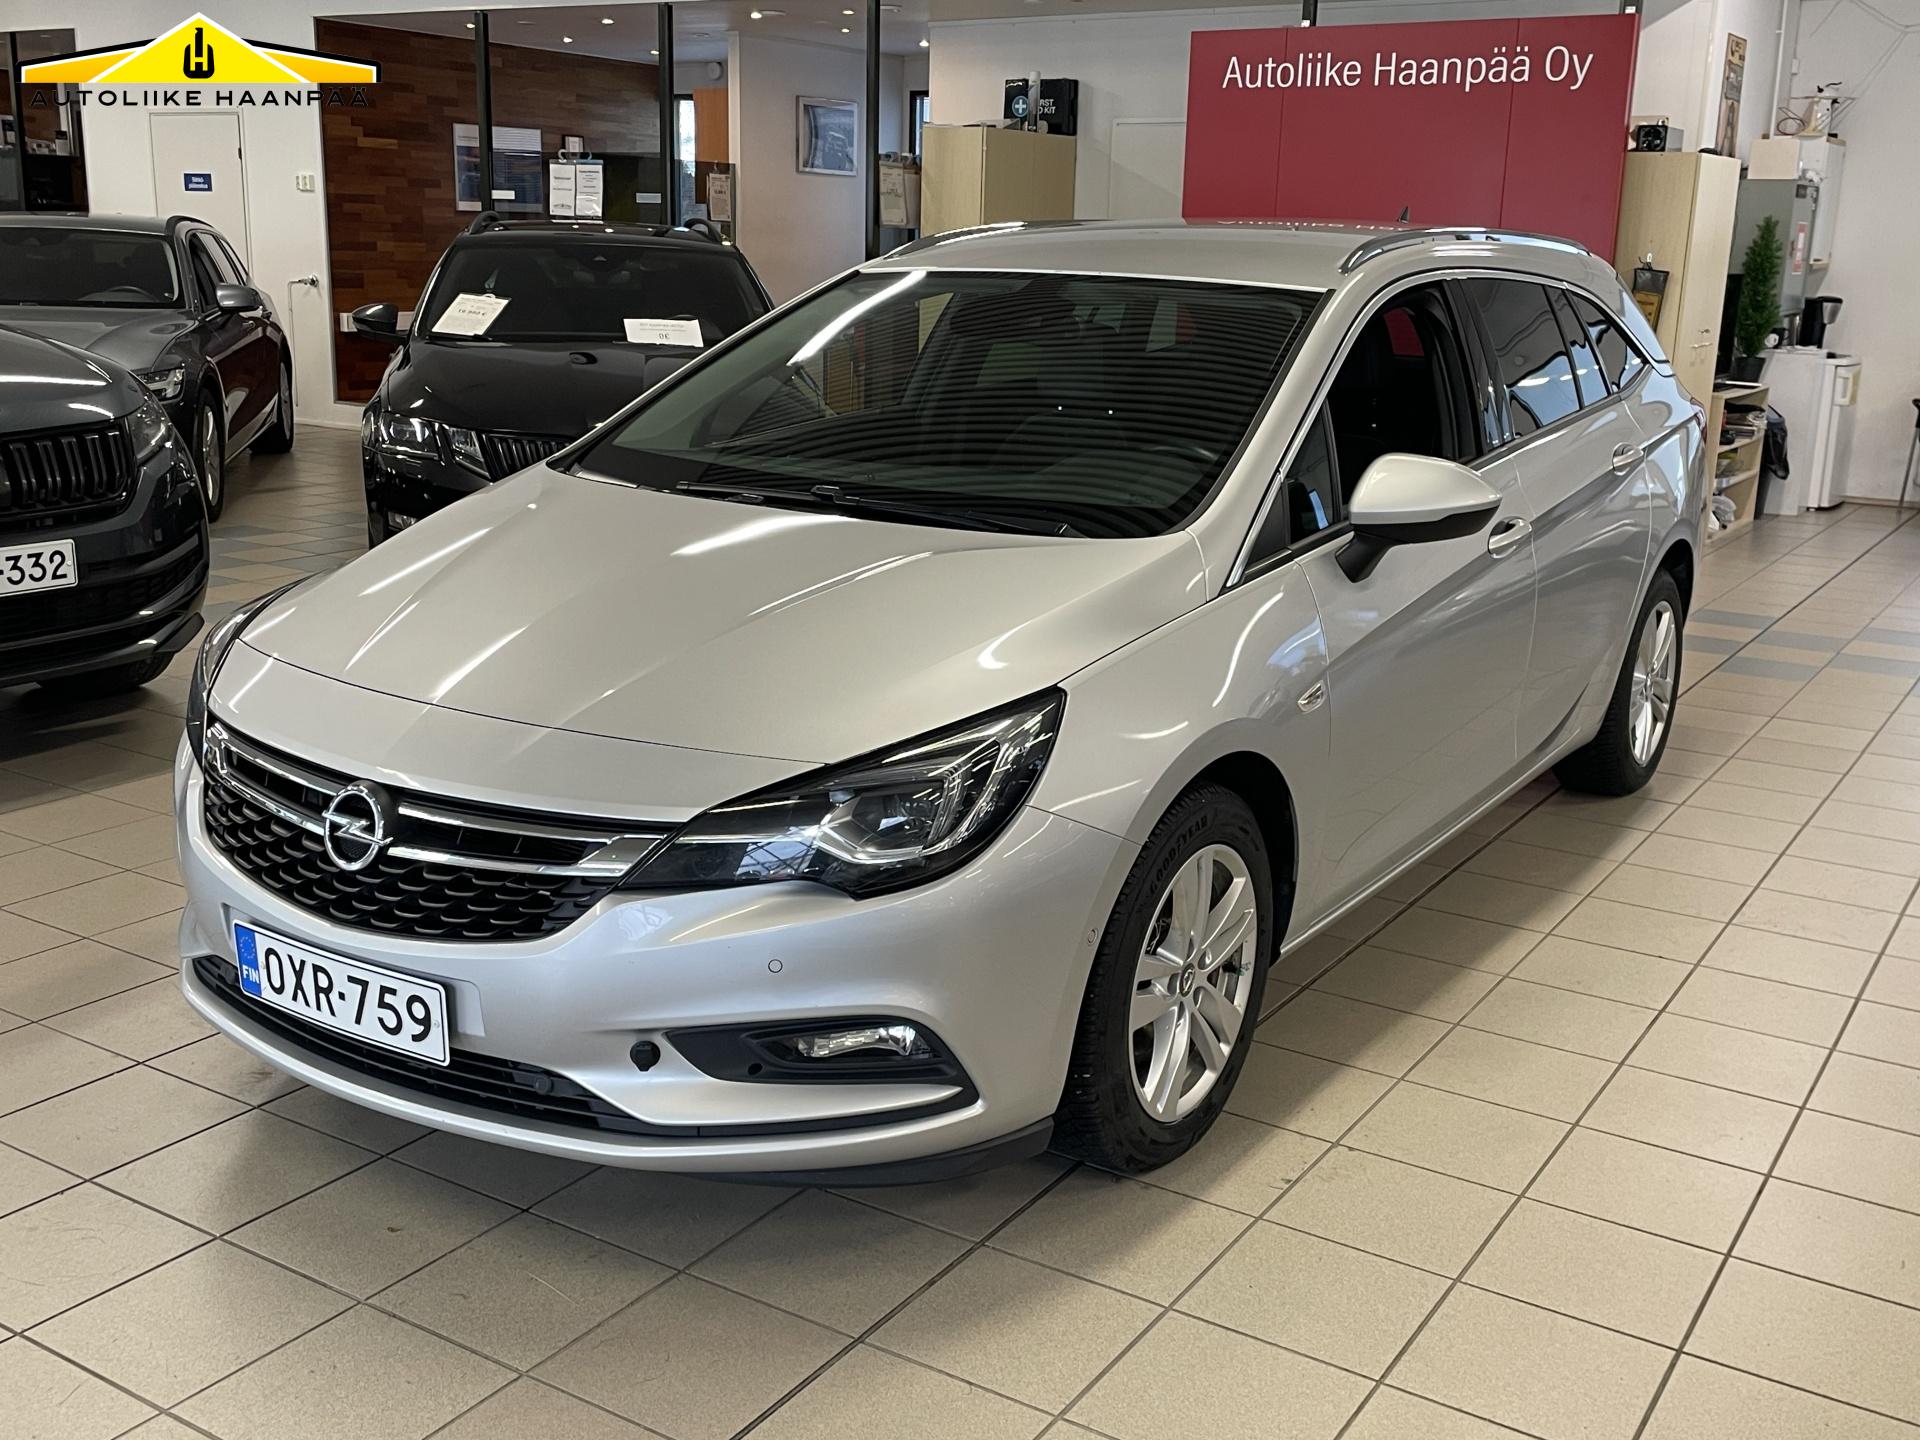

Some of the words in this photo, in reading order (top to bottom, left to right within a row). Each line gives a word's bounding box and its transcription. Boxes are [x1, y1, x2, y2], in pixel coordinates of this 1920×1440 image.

[1222, 51, 1362, 88] Autoliike
[1374, 46, 1530, 92] Haanpää
[1545, 45, 1594, 90] Oy
[242, 965, 260, 984] FIN
[264, 947, 432, 1043] OXR-759
